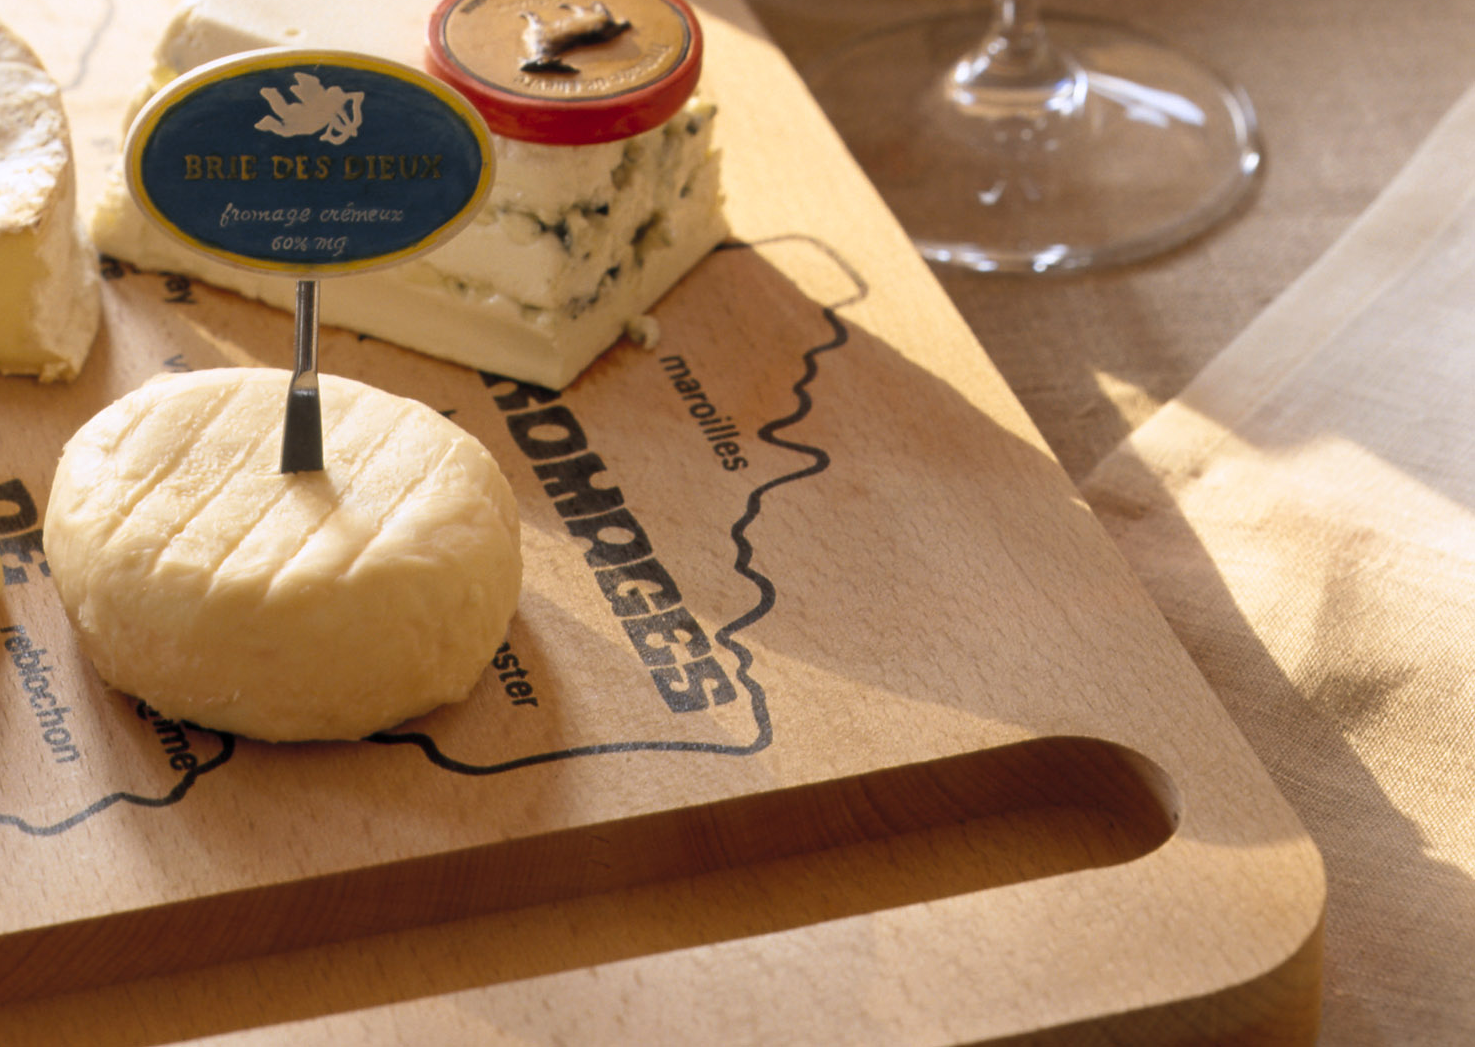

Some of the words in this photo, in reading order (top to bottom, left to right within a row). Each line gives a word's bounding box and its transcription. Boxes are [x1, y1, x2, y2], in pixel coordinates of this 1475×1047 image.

[183, 153, 258, 181] BRIE
[271, 154, 333, 181] DES
[343, 154, 444, 181] DIEUX
[219, 202, 311, 228] fromage
[271, 235, 308, 252] 60%
[313, 235, 349, 257] mg
[659, 354, 750, 473] maroilles
[0, 623, 81, 764] reblochon
